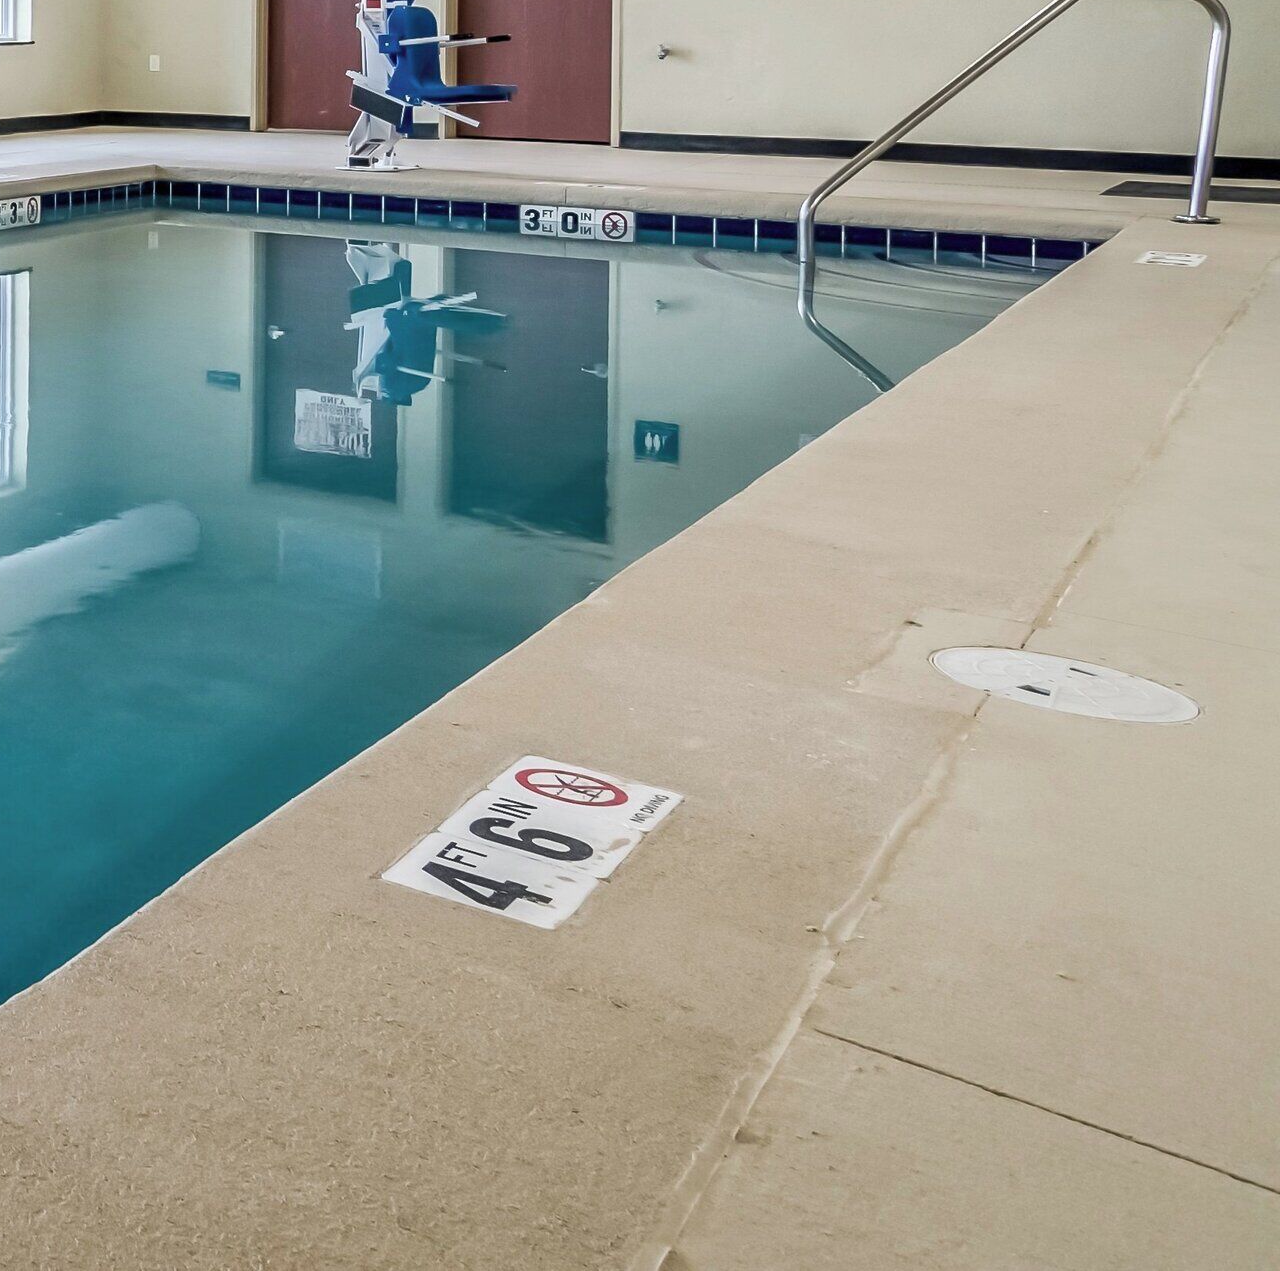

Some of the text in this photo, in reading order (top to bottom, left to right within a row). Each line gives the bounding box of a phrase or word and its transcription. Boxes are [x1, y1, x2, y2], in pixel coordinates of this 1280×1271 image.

[524, 208, 592, 233] 3 FT 0 IN
[640, 794, 670, 814] DIVING
[421, 797, 594, 911] 4 FT 6 IN
